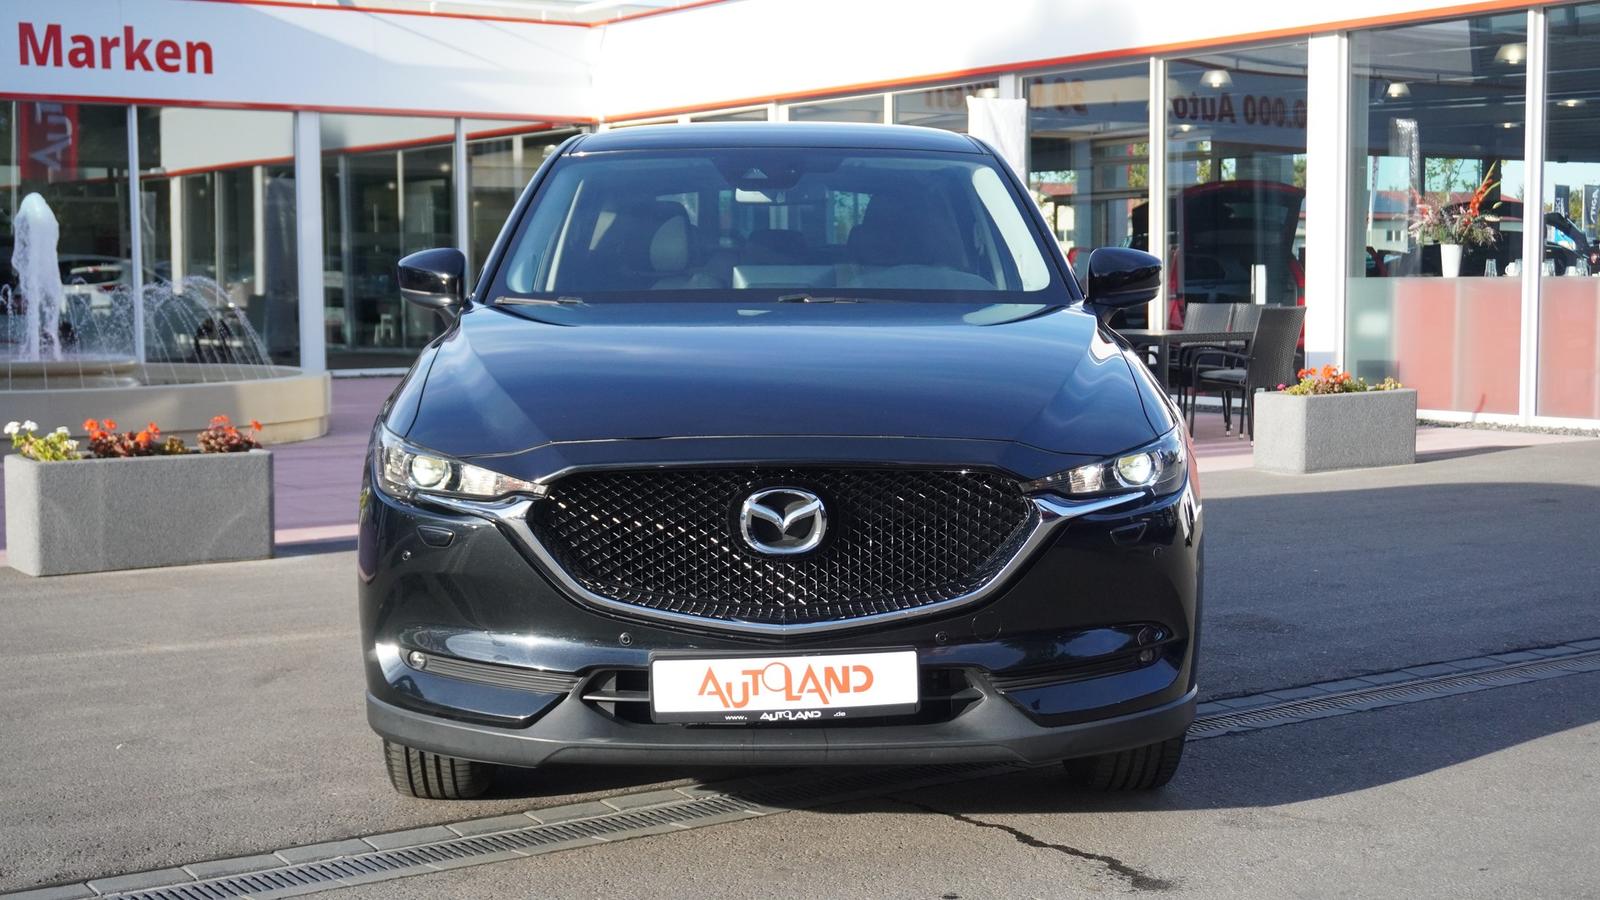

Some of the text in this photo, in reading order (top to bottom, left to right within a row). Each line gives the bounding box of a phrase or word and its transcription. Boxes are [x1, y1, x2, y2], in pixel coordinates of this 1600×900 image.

[18, 22, 214, 75] Marken
[697, 661, 875, 709] AUTOLAND
[759, 710, 822, 721] AUTOLAND
